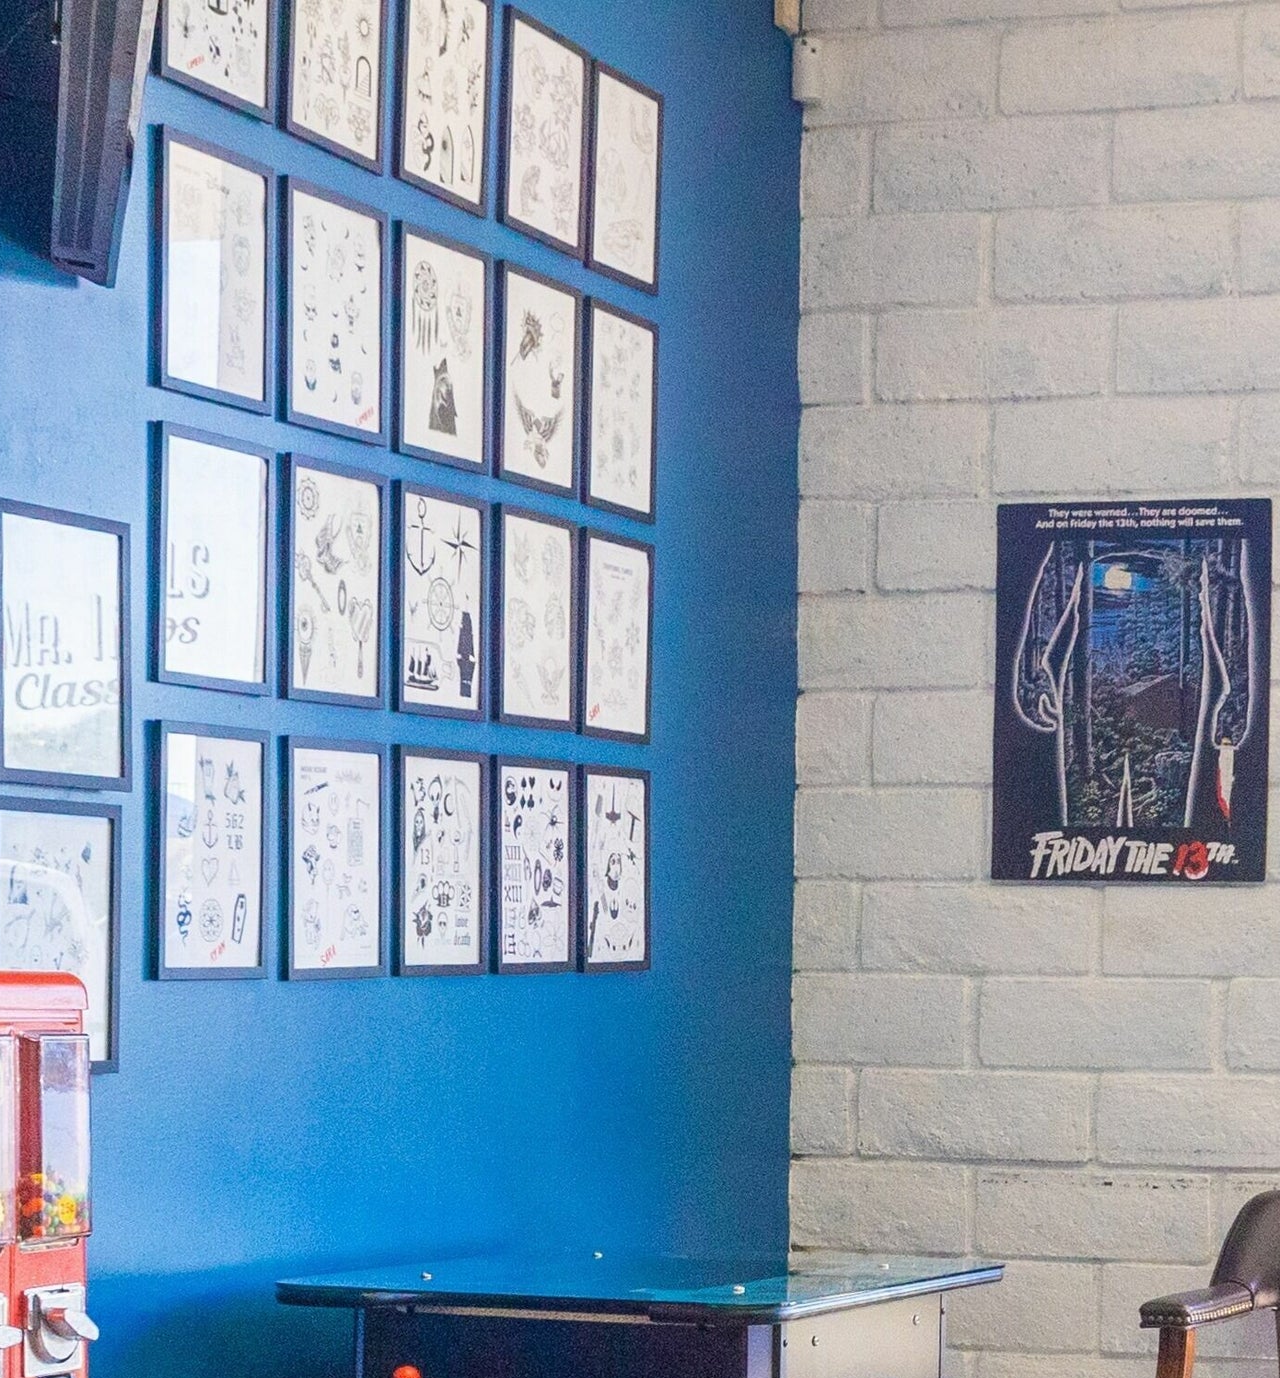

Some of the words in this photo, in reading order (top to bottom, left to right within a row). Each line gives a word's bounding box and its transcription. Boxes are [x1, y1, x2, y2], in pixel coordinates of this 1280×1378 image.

[1048, 508, 1070, 519] They
[1071, 509, 1093, 517] were
[1161, 508, 1177, 516] are
[1035, 519, 1055, 529] And
[1055, 520, 1069, 529] on
[1070, 519, 1097, 529] Friday
[1098, 519, 1114, 528] the
[1115, 518, 1139, 529] 13th,
[1140, 518, 1177, 529] nothing
[1177, 517, 1194, 527] will
[1195, 518, 1216, 527] save
[1030, 831, 1127, 879] FRIDAY
[1124, 840, 1174, 875] THE
